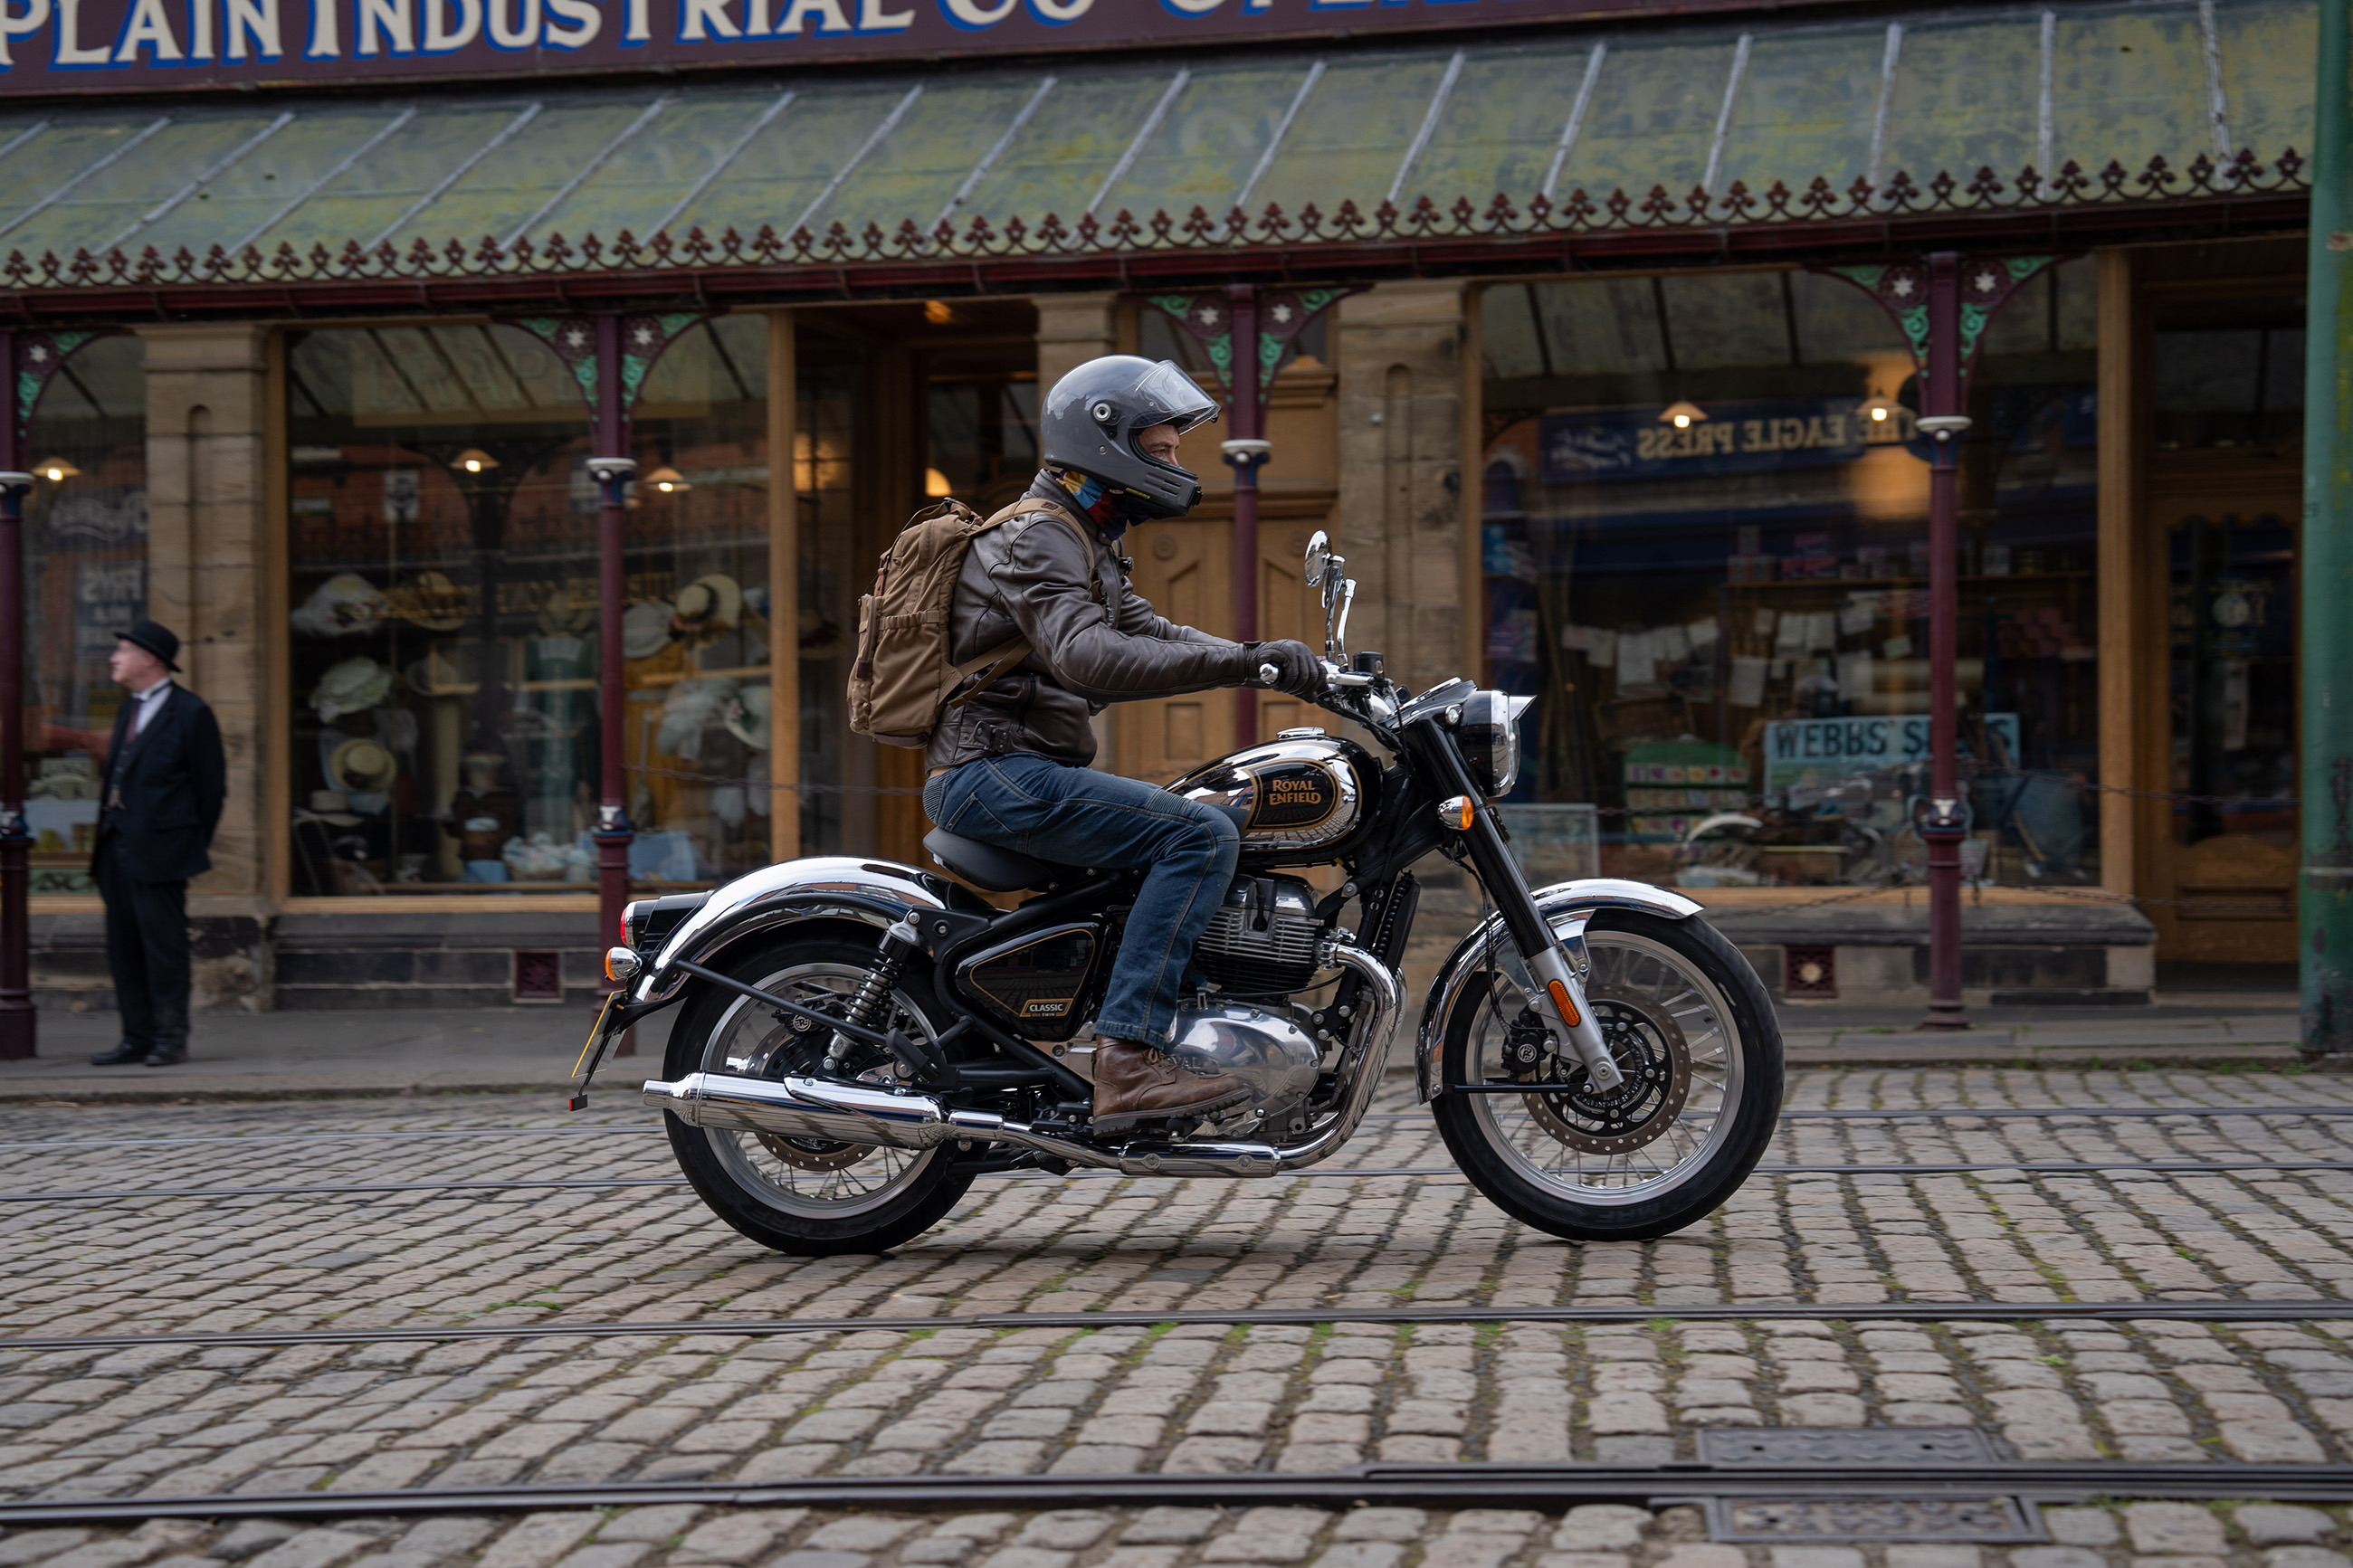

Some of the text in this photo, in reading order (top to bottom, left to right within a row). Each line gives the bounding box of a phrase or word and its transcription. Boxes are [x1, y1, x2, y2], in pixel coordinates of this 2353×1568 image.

[0, 0, 283, 71] PLAIN
[1272, 779, 1316, 792] ROYAL
[1269, 792, 1321, 805] ENFIELD
[1029, 1003, 1063, 1012] CLASSIC
